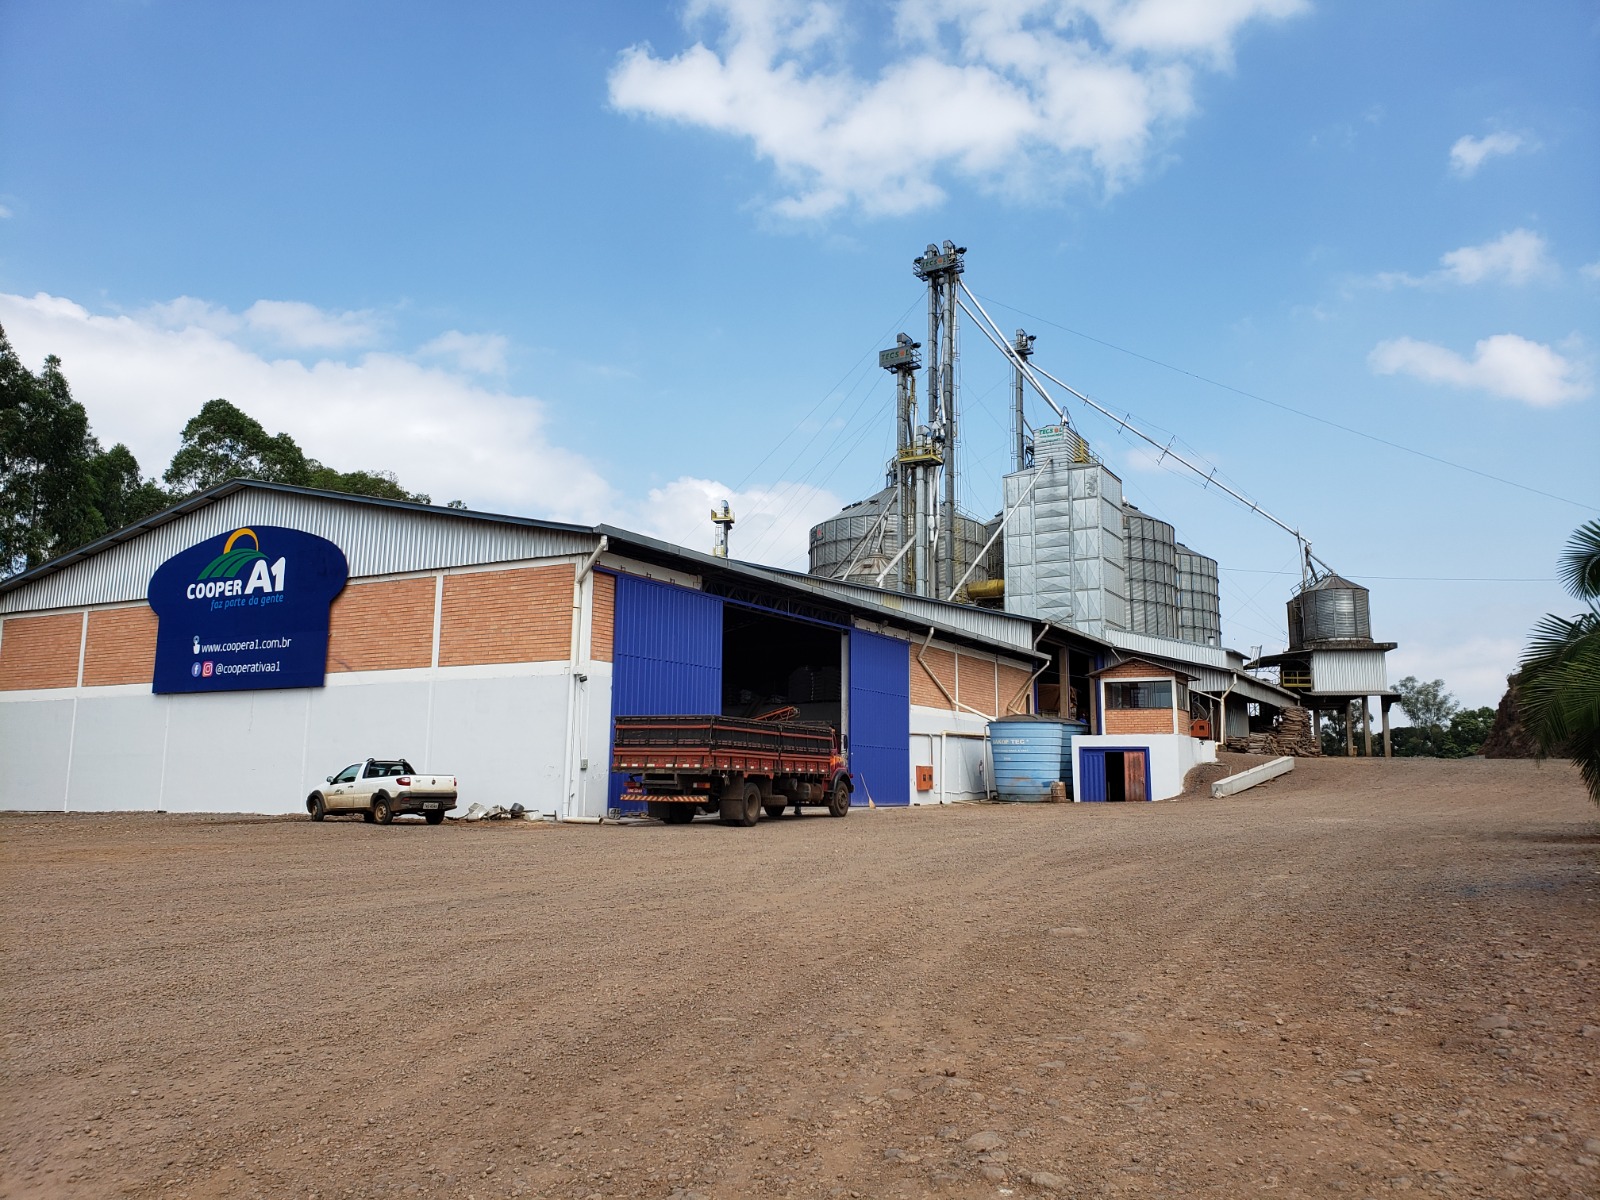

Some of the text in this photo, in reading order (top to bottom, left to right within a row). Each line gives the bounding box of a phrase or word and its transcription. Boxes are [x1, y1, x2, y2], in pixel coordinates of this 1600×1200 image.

[187, 556, 286, 599] COOPER A1
[210, 594, 284, 611] faz parte da gente
[201, 636, 292, 653] www.coopera1.com.br
[215, 661, 281, 675] @cooperativaa1
